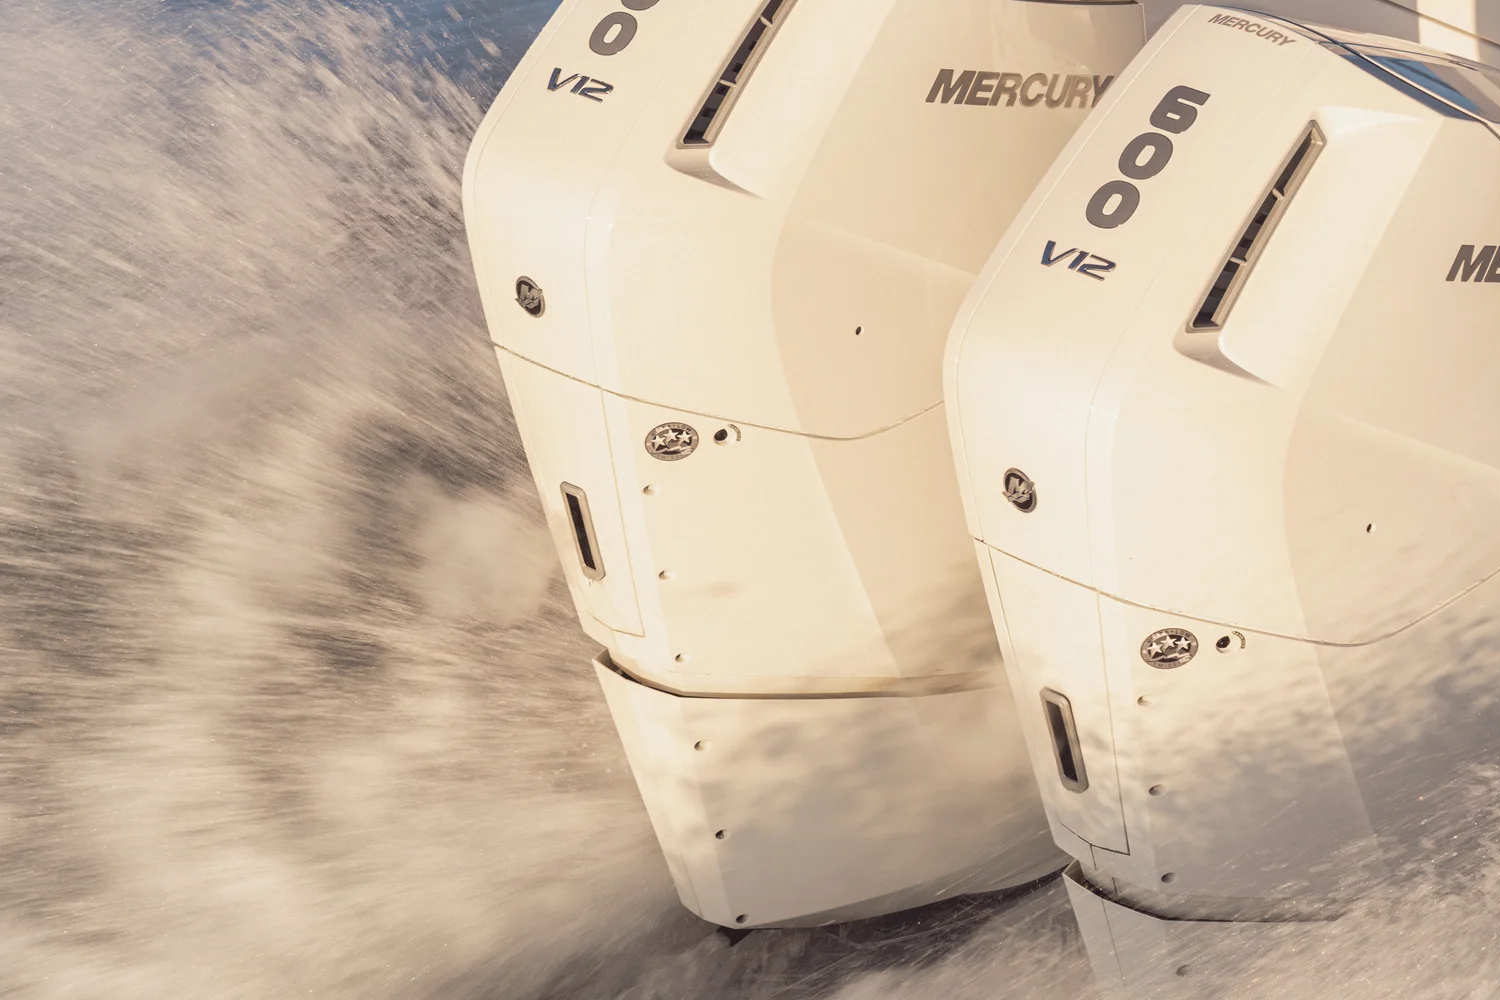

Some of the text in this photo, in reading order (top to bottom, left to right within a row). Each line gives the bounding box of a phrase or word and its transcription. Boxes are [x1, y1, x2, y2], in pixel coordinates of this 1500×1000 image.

[1207, 13, 1297, 46] MERCURY
[547, 67, 614, 103] V12
[925, 68, 1114, 109] MERCURY
[1085, 85, 1211, 229] 600
[1041, 239, 1117, 281] V12
